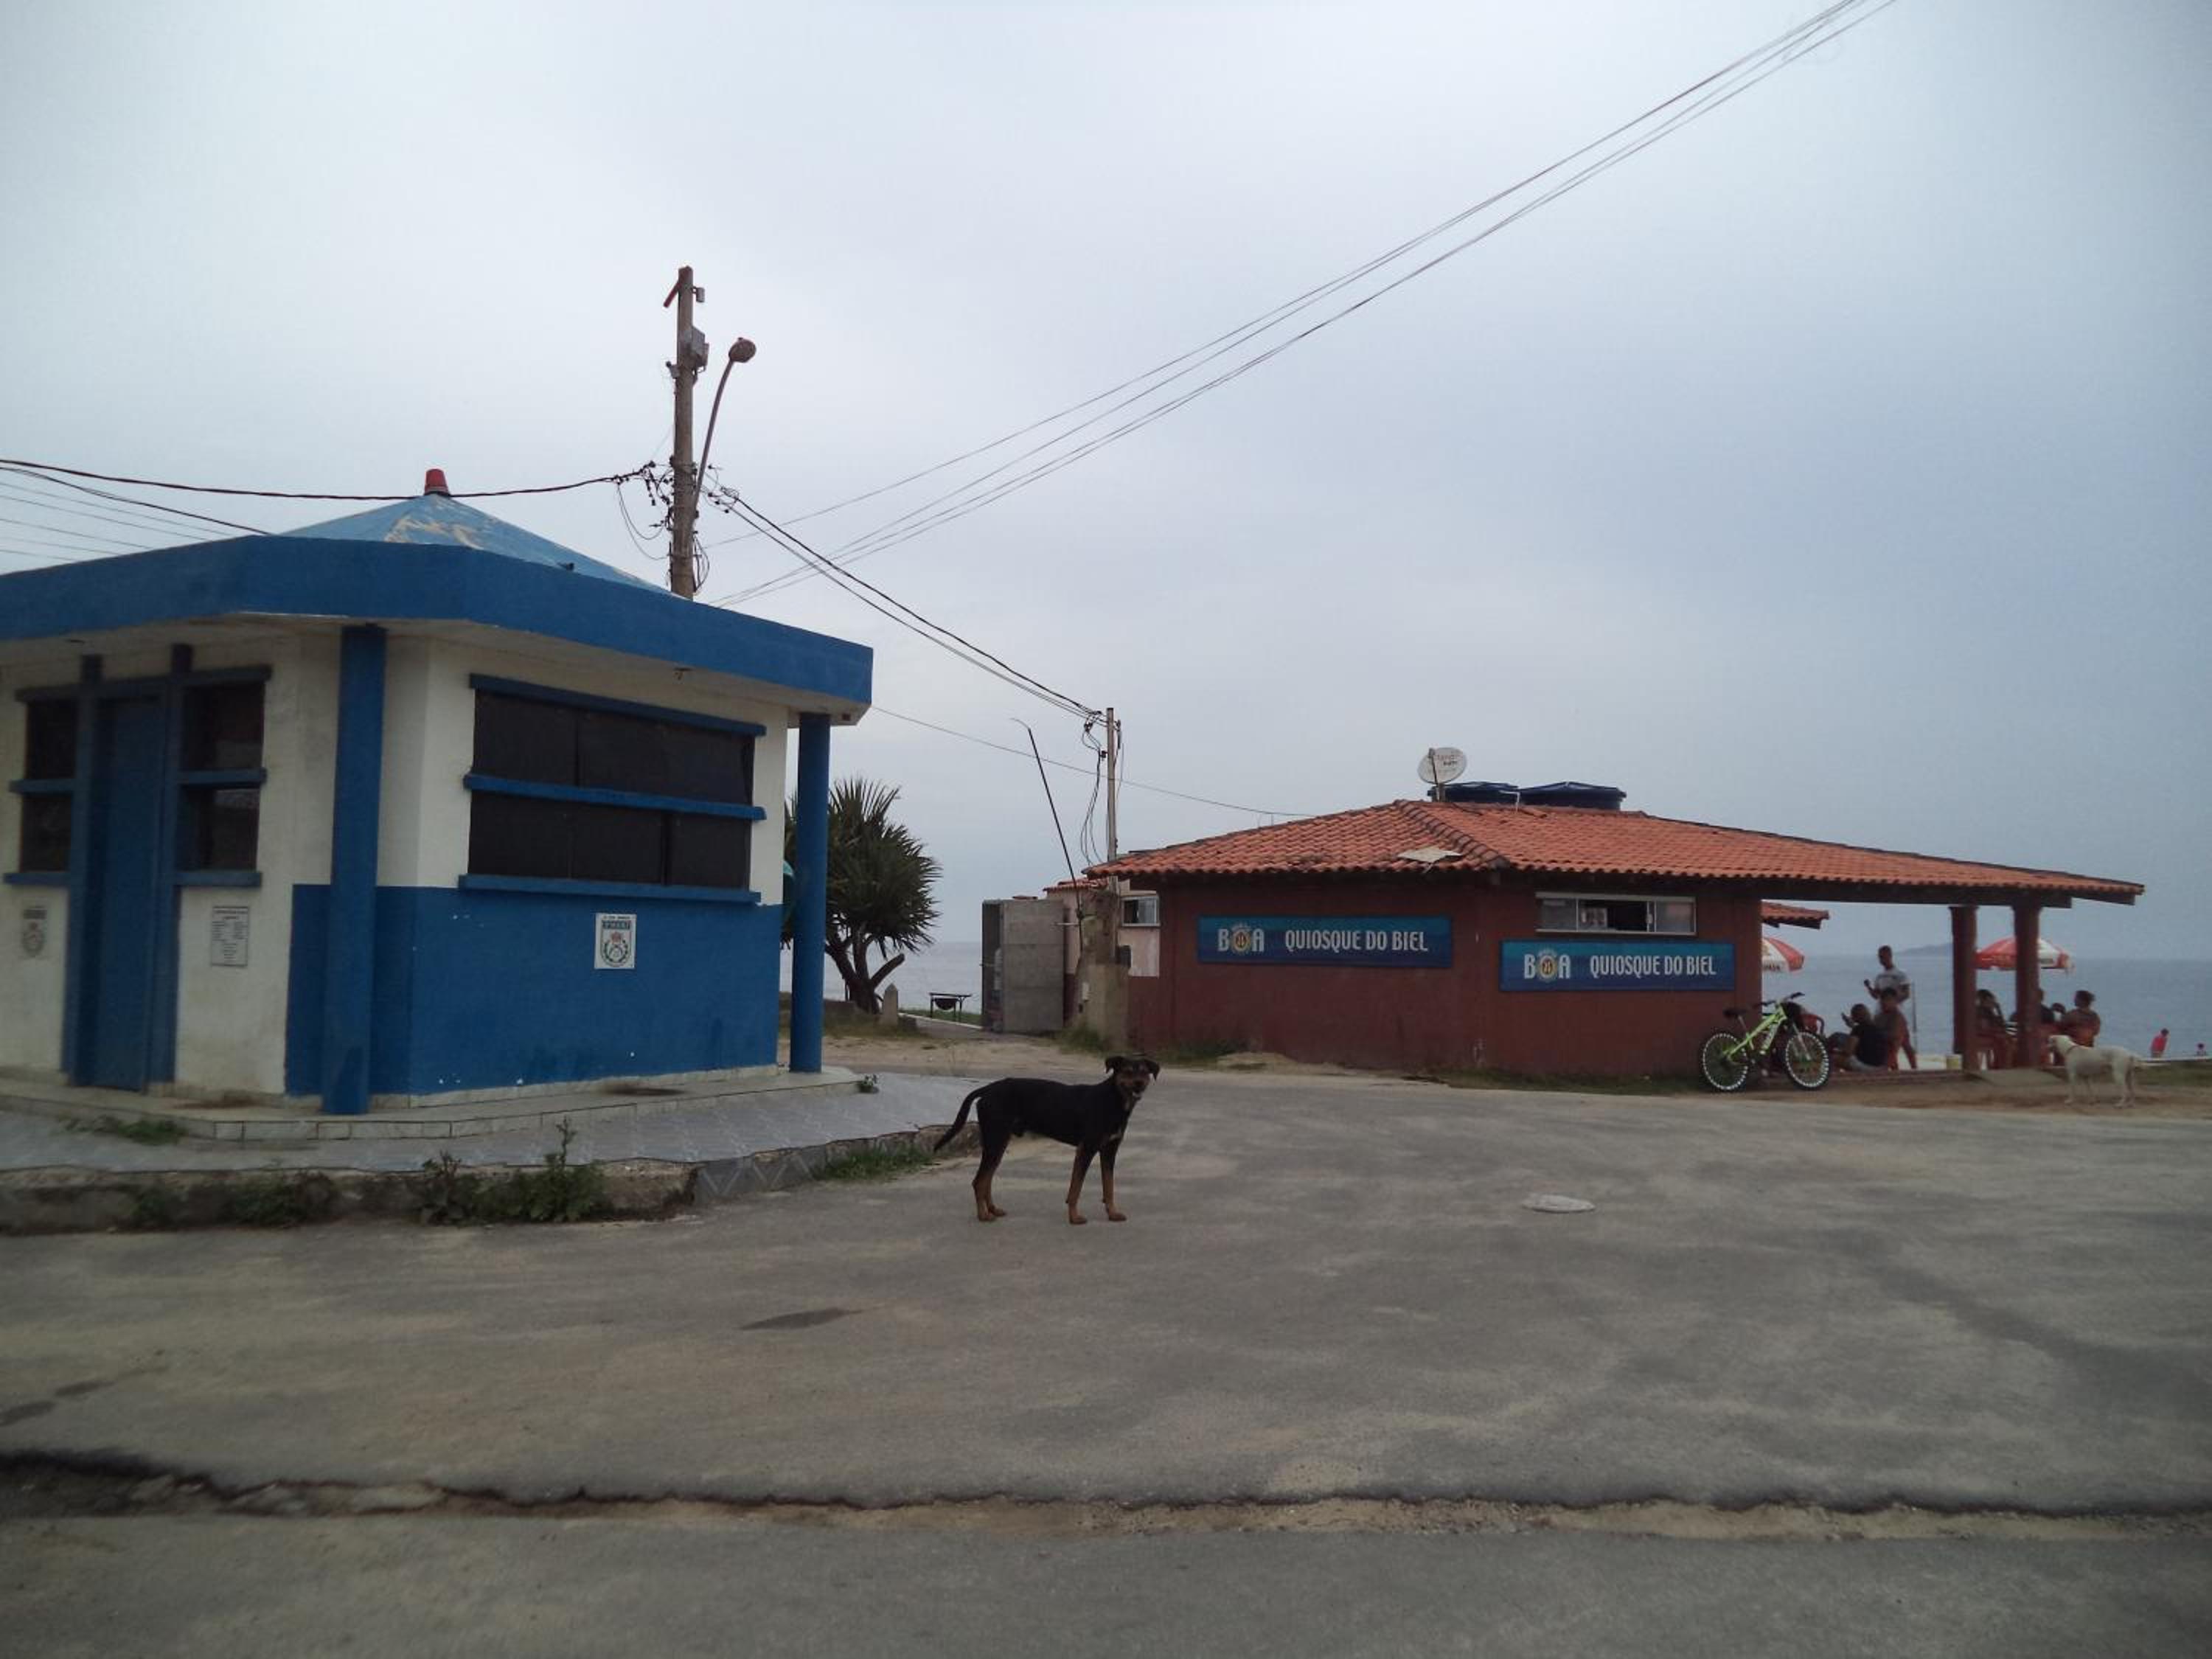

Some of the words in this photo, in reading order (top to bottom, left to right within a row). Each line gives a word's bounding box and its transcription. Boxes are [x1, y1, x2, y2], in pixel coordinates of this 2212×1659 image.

[1285, 930, 1361, 953] QUIOSQUE
[1366, 931, 1387, 950] DO
[1391, 931, 1428, 951] BIEL
[1590, 955, 1660, 978] QUIOSQUE
[1664, 955, 1683, 975] DO
[1686, 955, 1717, 975] BIEL
